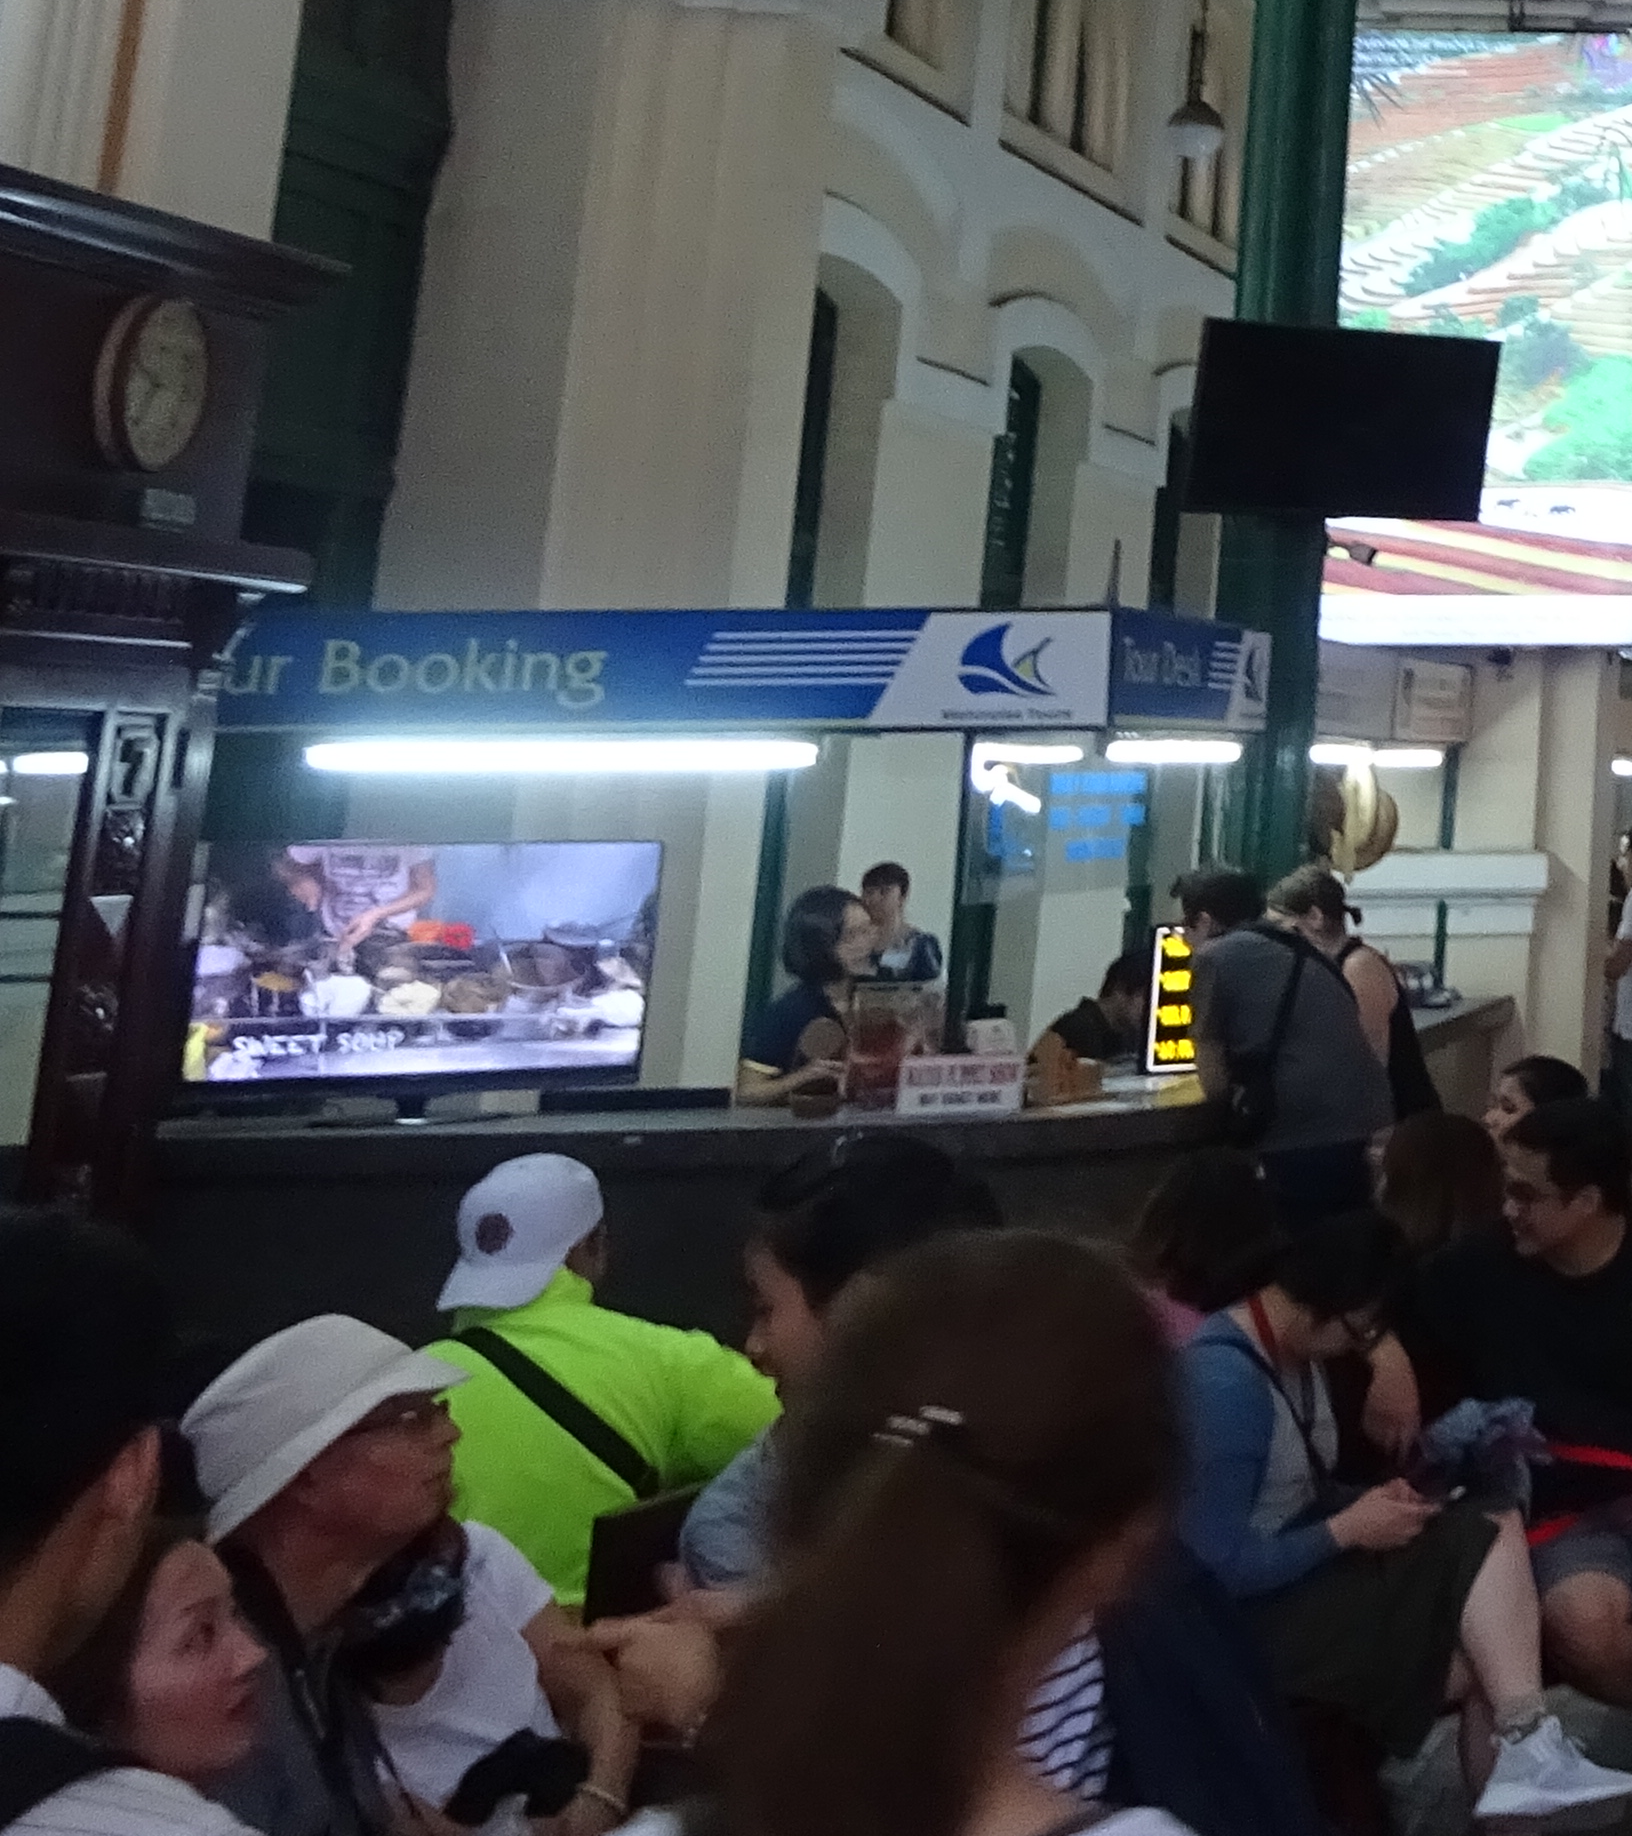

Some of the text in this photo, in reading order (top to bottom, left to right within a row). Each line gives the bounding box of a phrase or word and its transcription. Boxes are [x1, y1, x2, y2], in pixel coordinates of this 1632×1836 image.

[223, 638, 608, 710] ur Booking
[232, 1029, 405, 1056] SWEET SOUP
